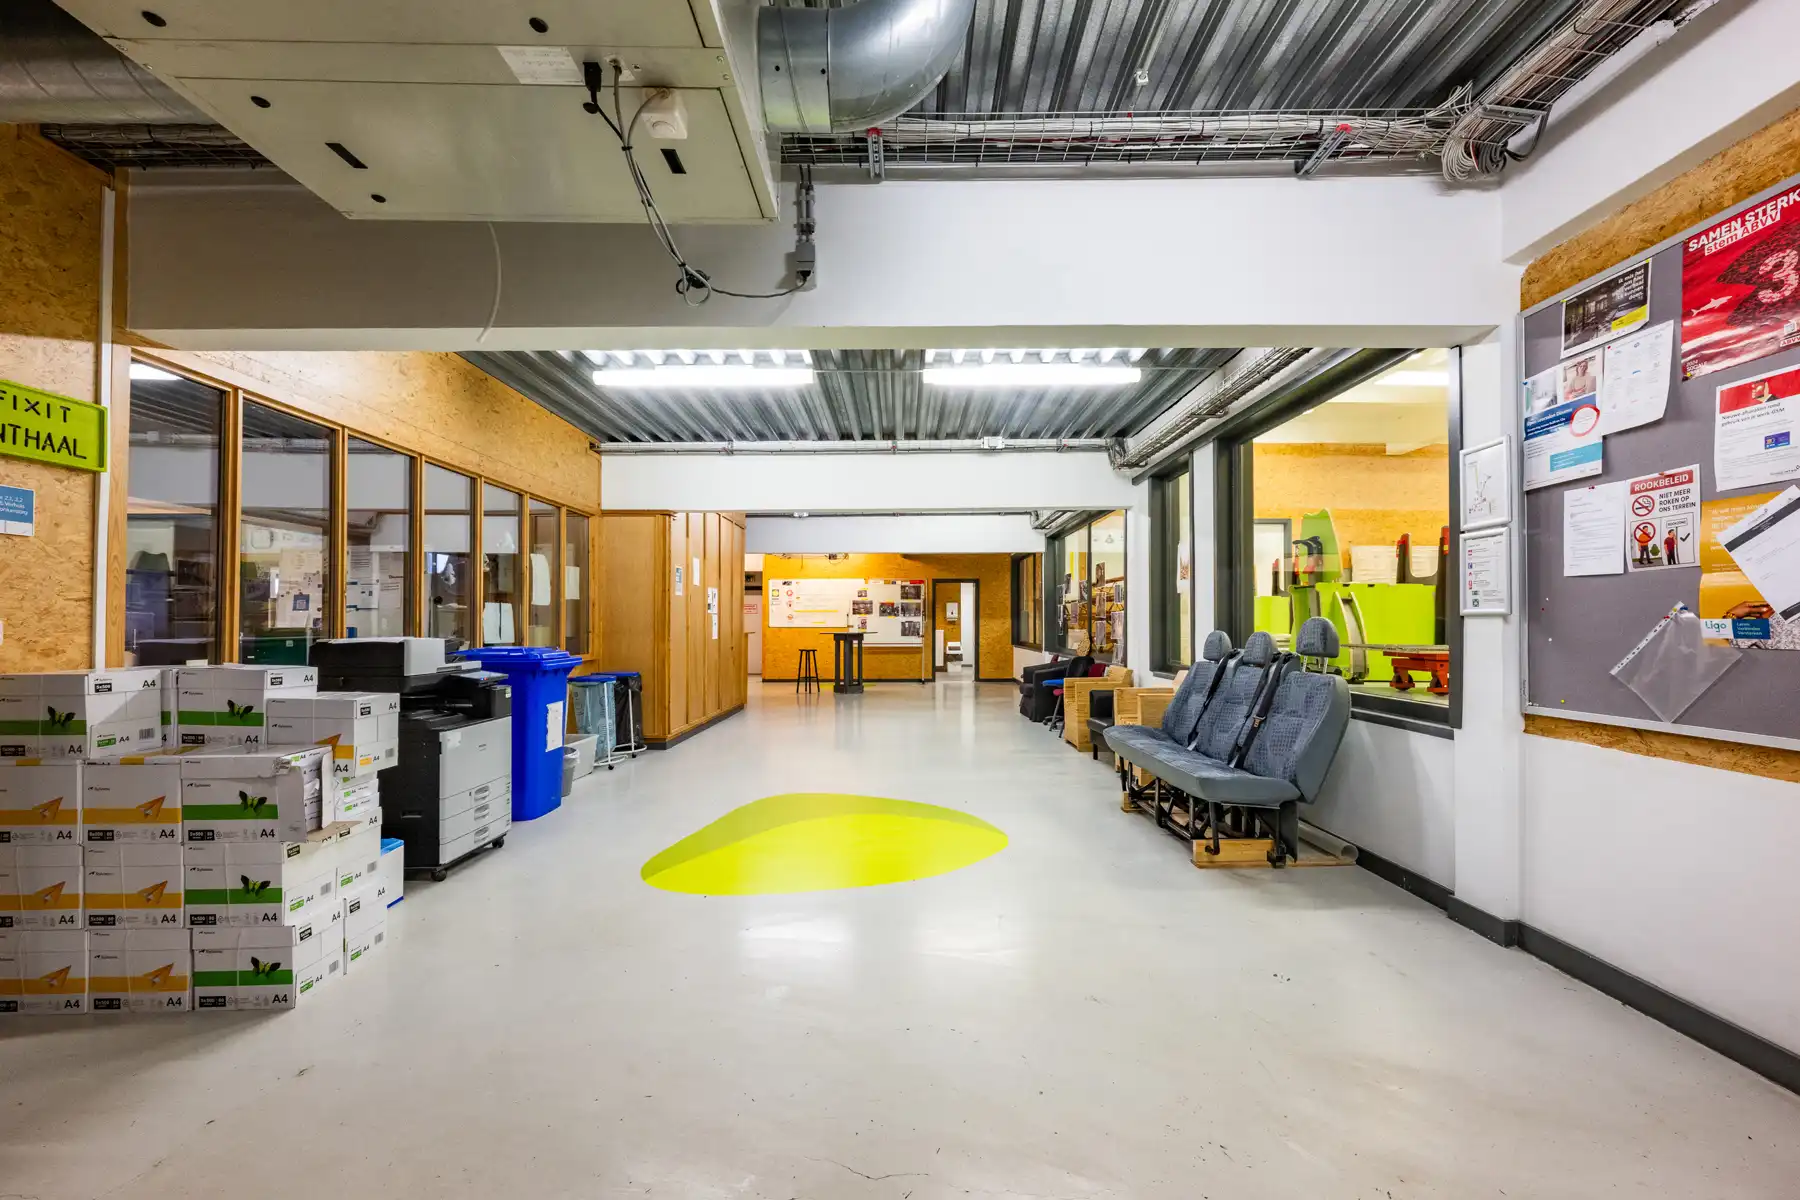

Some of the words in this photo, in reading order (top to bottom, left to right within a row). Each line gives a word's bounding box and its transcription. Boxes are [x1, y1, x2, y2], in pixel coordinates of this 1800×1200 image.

[1688, 217, 1741, 252] SAMEN
[1745, 188, 1800, 225] STERK
[1706, 234, 1738, 254] stem
[1741, 213, 1778, 238] ABVV
[1634, 474, 1689, 491] ROOKBELEID
[1659, 491, 1673, 499] NIET
[1674, 488, 1691, 496] MEER
[1659, 498, 1680, 506] ROKEN
[1672, 502, 1696, 511] TERREIN
[303, 674, 314, 682] A4
[142, 679, 157, 688] A4
[388, 702, 397, 711] A4
[118, 735, 130, 743] A4
[244, 735, 259, 744] A4
[68, 744, 83, 754] A4
[334, 763, 349, 773] A4
[368, 816, 378, 826] A4
[56, 830, 73, 840] A4
[159, 829, 175, 839] A4
[260, 828, 275, 838] A4
[377, 887, 386, 897] A4
[306, 894, 314, 903] A4
[58, 915, 75, 925] A4
[160, 914, 177, 924] A4
[261, 912, 278, 922] A4
[331, 911, 341, 923] A4
[166, 997, 182, 1007] A4
[271, 993, 288, 1004] A4
[64, 999, 80, 1009] A4
